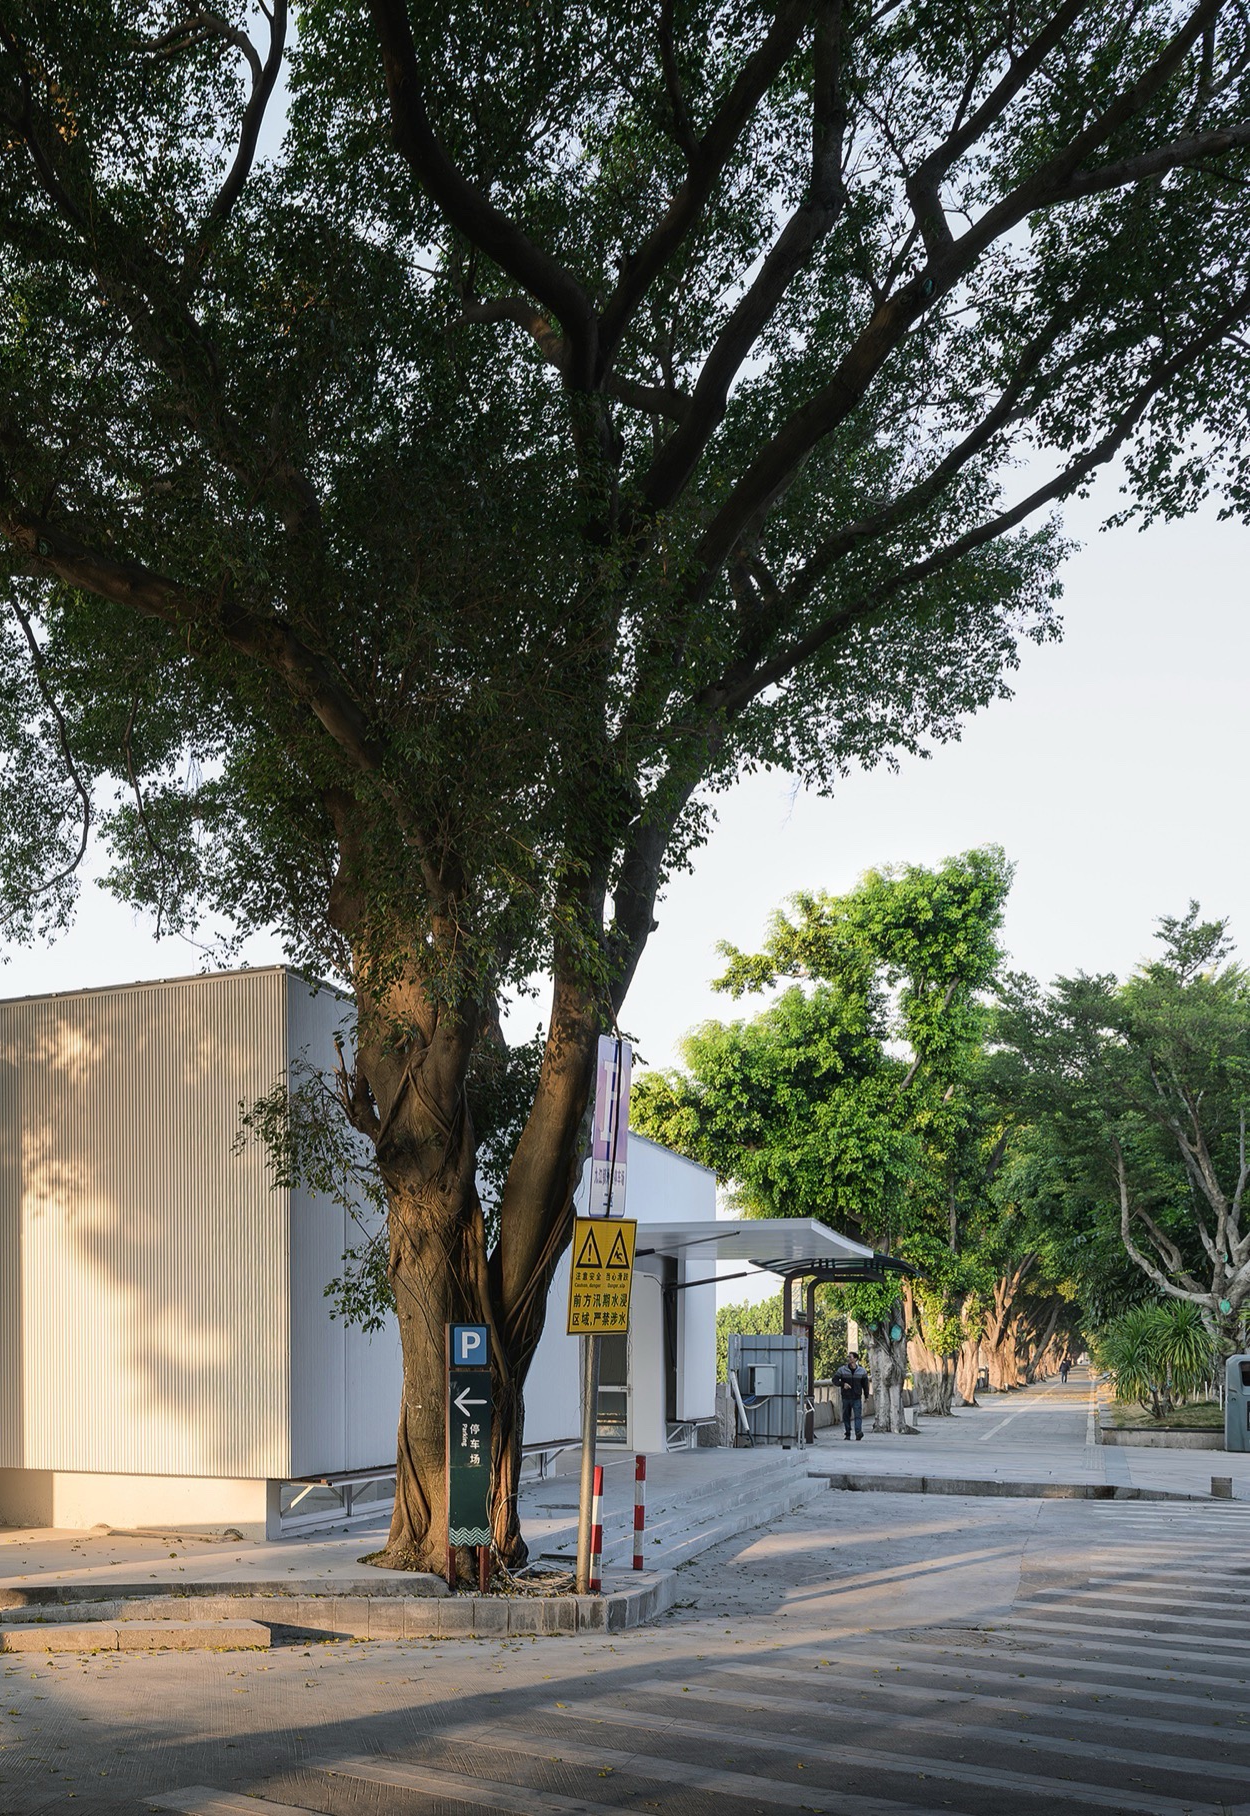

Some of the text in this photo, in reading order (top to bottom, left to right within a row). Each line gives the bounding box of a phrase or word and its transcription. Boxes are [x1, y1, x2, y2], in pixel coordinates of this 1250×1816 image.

[575, 1271, 601, 1280] 注意安全
[462, 1331, 481, 1359] P
[469, 1423, 480, 1465] 停车场
